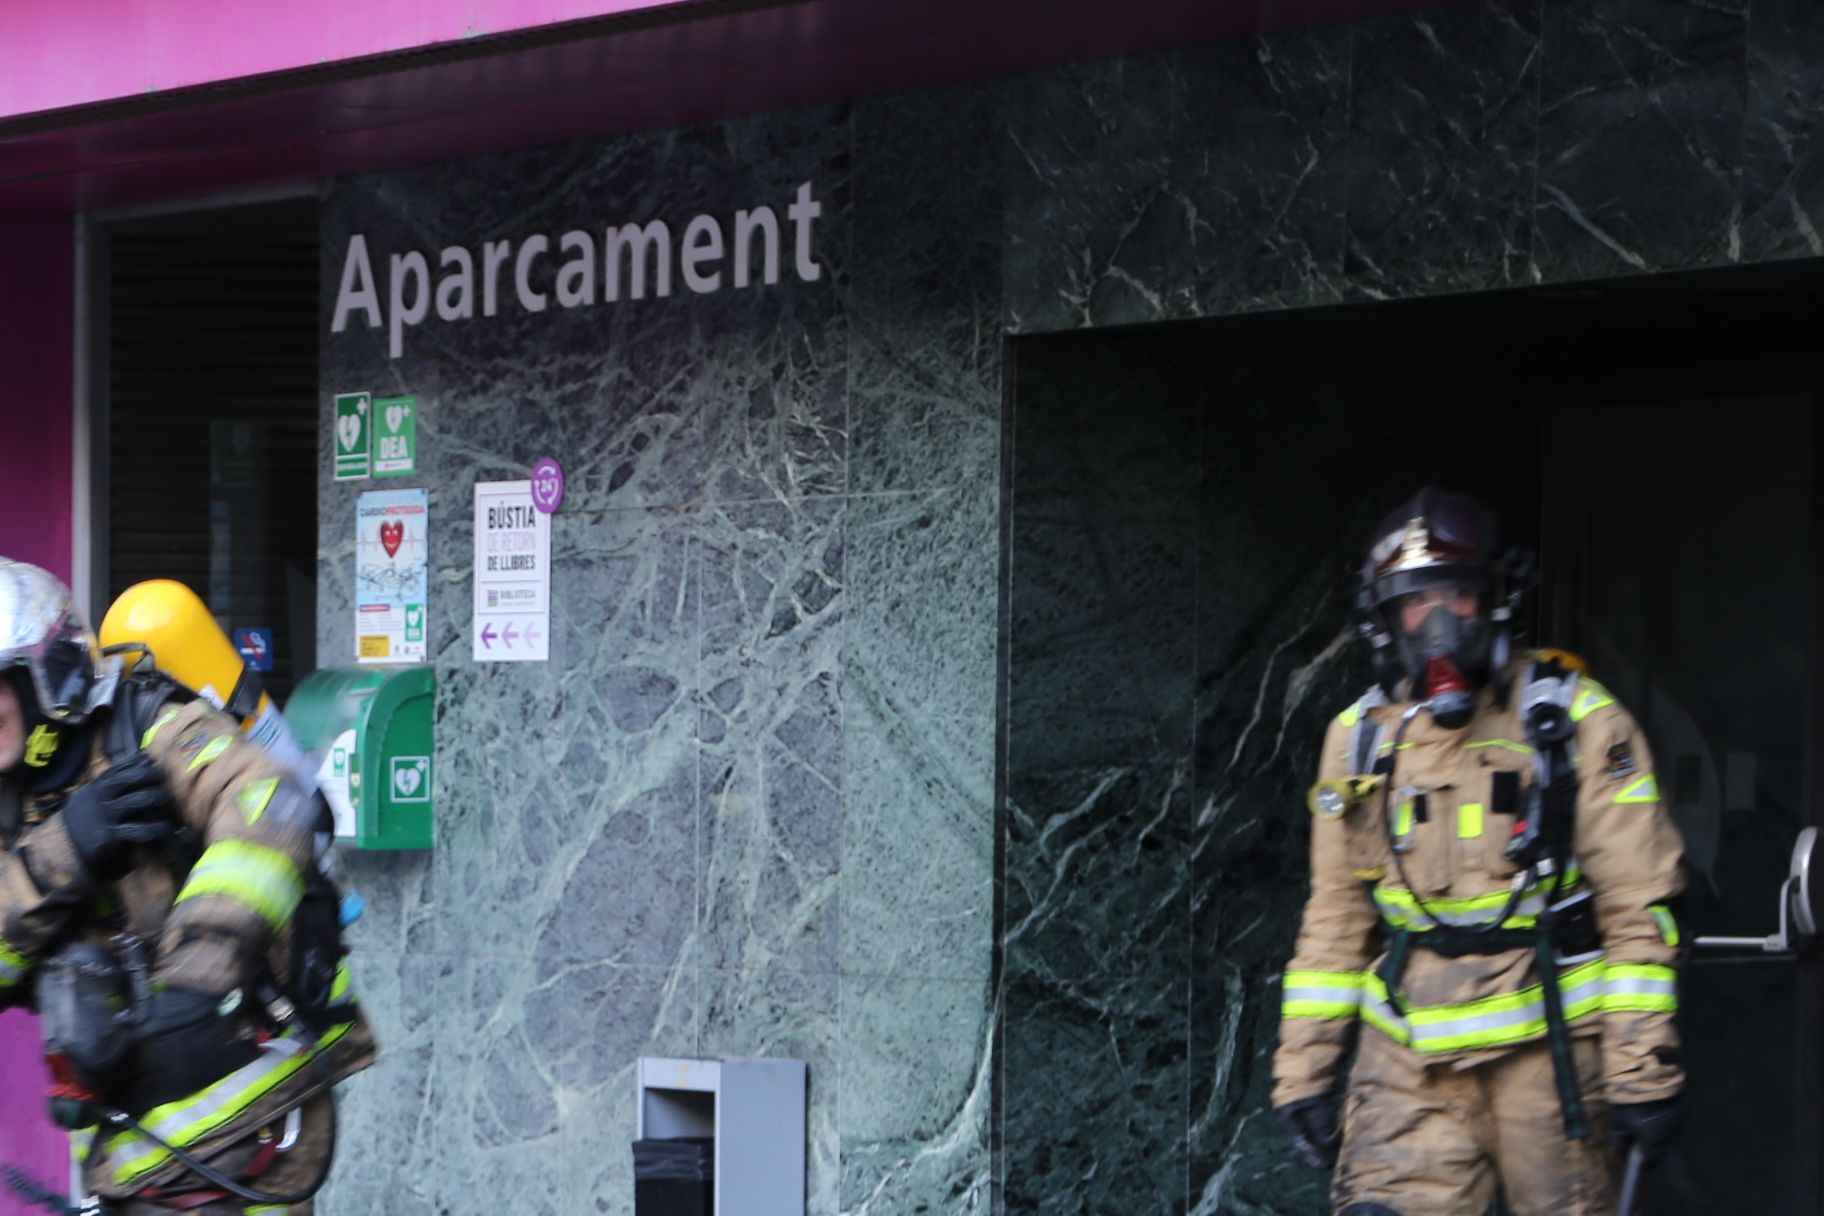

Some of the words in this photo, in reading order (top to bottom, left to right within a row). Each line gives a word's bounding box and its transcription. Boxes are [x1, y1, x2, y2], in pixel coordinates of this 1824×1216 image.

[330, 180, 823, 359] Aparcament
[380, 435, 408, 459] DEA
[488, 501, 536, 529] BÚSTIA
[488, 533, 499, 552] DE
[488, 556, 499, 571] DE
[501, 555, 536, 571] LLIBRES
